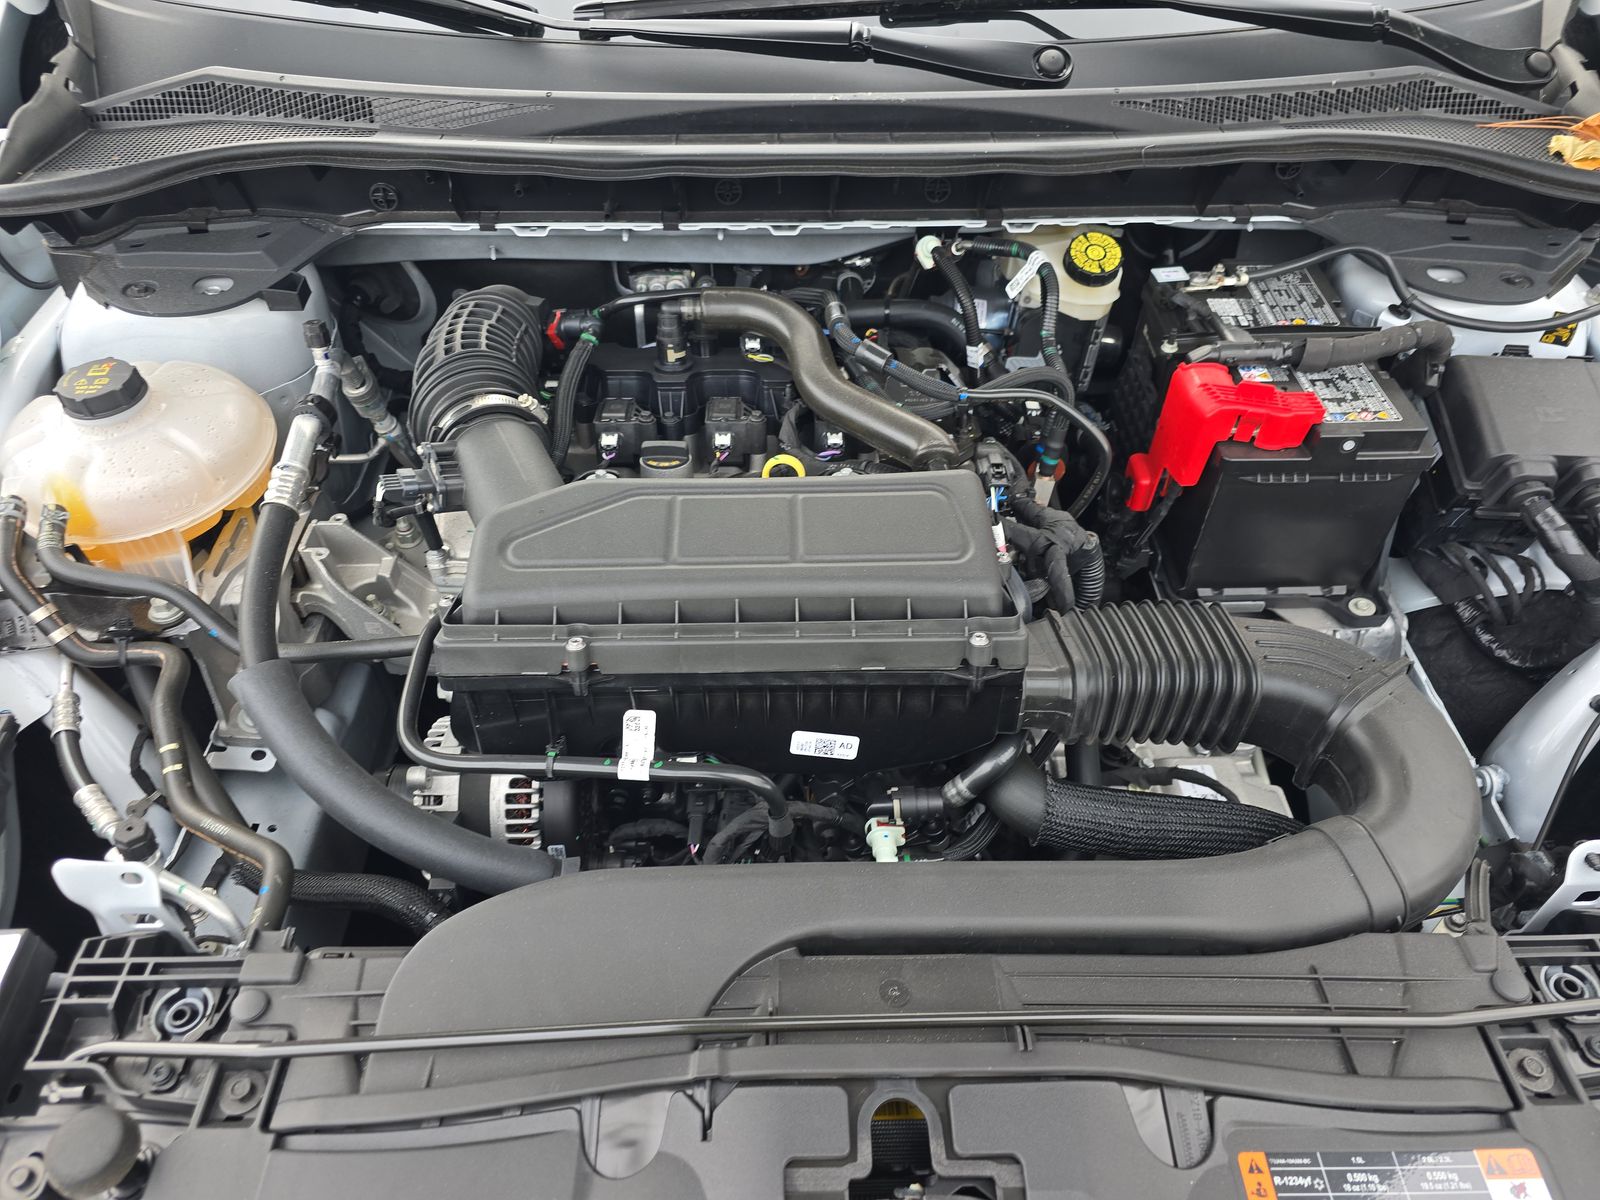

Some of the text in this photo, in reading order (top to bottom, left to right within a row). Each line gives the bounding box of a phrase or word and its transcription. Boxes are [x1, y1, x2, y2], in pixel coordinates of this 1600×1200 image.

[838, 742, 853, 750] AD
[1273, 1175, 1312, 1188] R-1234yf
[1367, 1172, 1380, 1184] kg
[1447, 1170, 1459, 1182] kg
